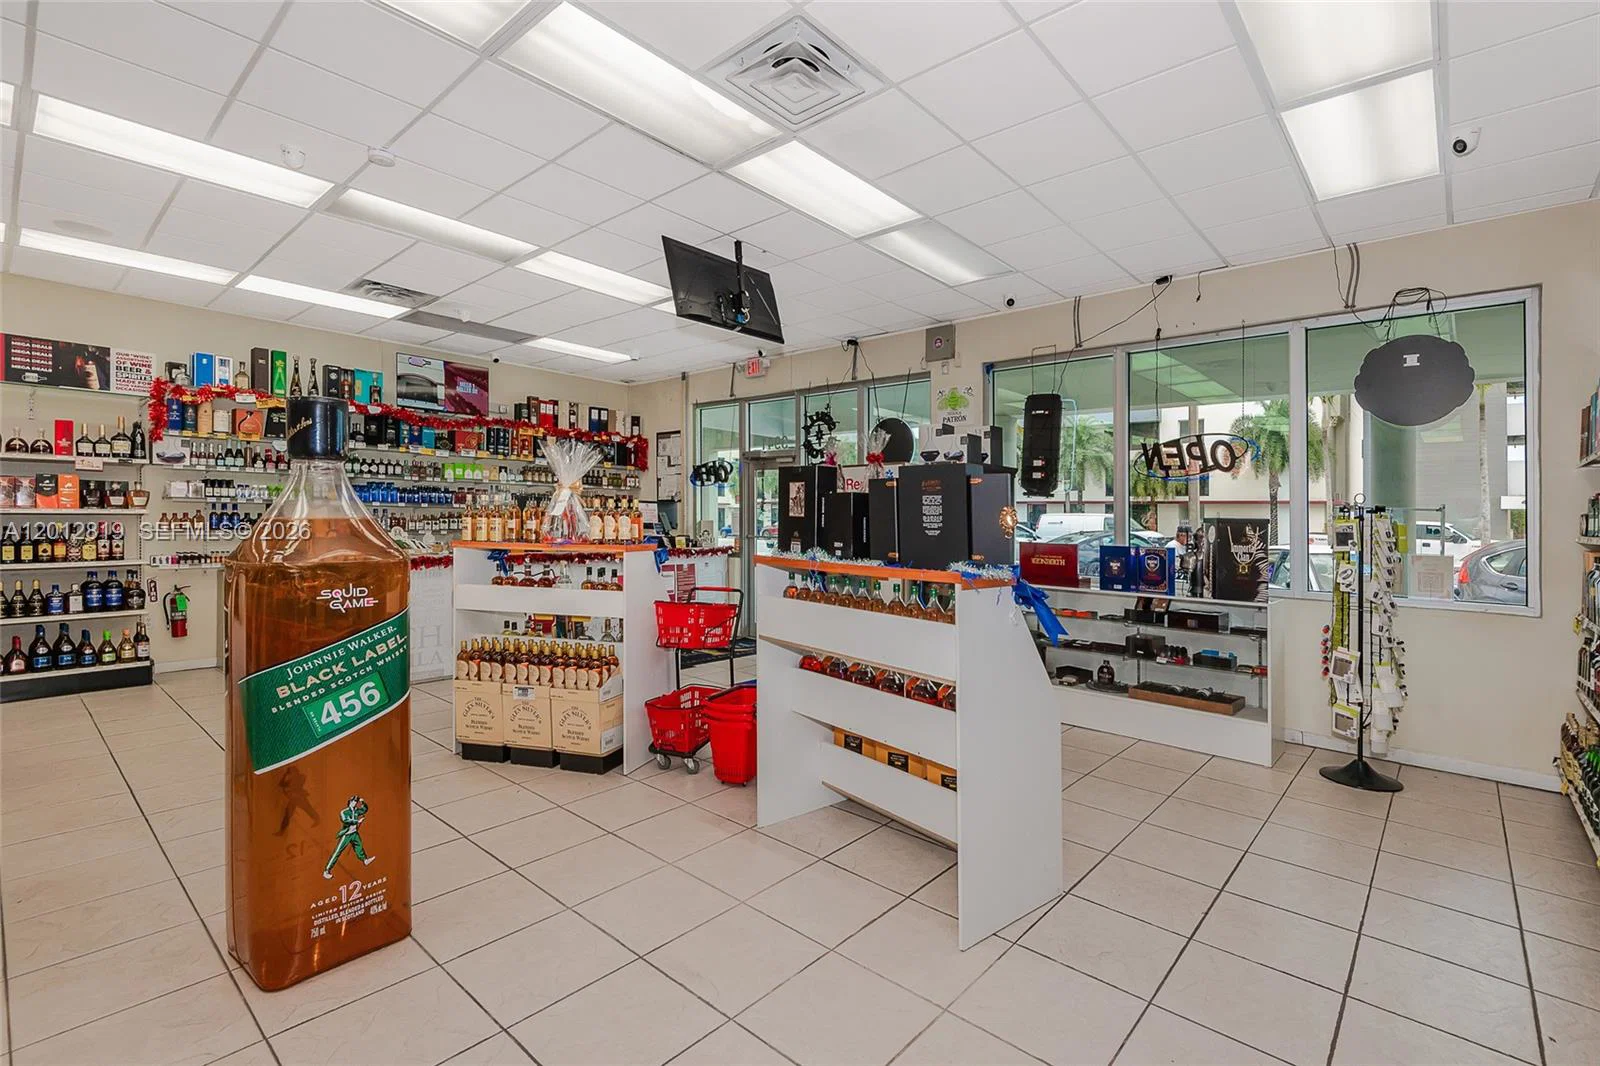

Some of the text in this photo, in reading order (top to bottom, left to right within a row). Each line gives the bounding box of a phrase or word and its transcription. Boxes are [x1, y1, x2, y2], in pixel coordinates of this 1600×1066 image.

[115, 365, 142, 373] BEER
[129, 361, 152, 369] WINE
[747, 358, 760, 376] EXIT
[316, 583, 369, 601] SQUID
[330, 597, 379, 613] GAME
[286, 648, 346, 680] JOHNNIE
[276, 661, 348, 699] BLACK
[271, 687, 326, 714] BLENDED
[330, 665, 374, 689] SCOTCH
[320, 681, 381, 724] 456
[310, 876, 387, 909] AGED 12 YEARS
[311, 907, 338, 920] LIMITED
[341, 909, 365, 921] SCOTLAND
